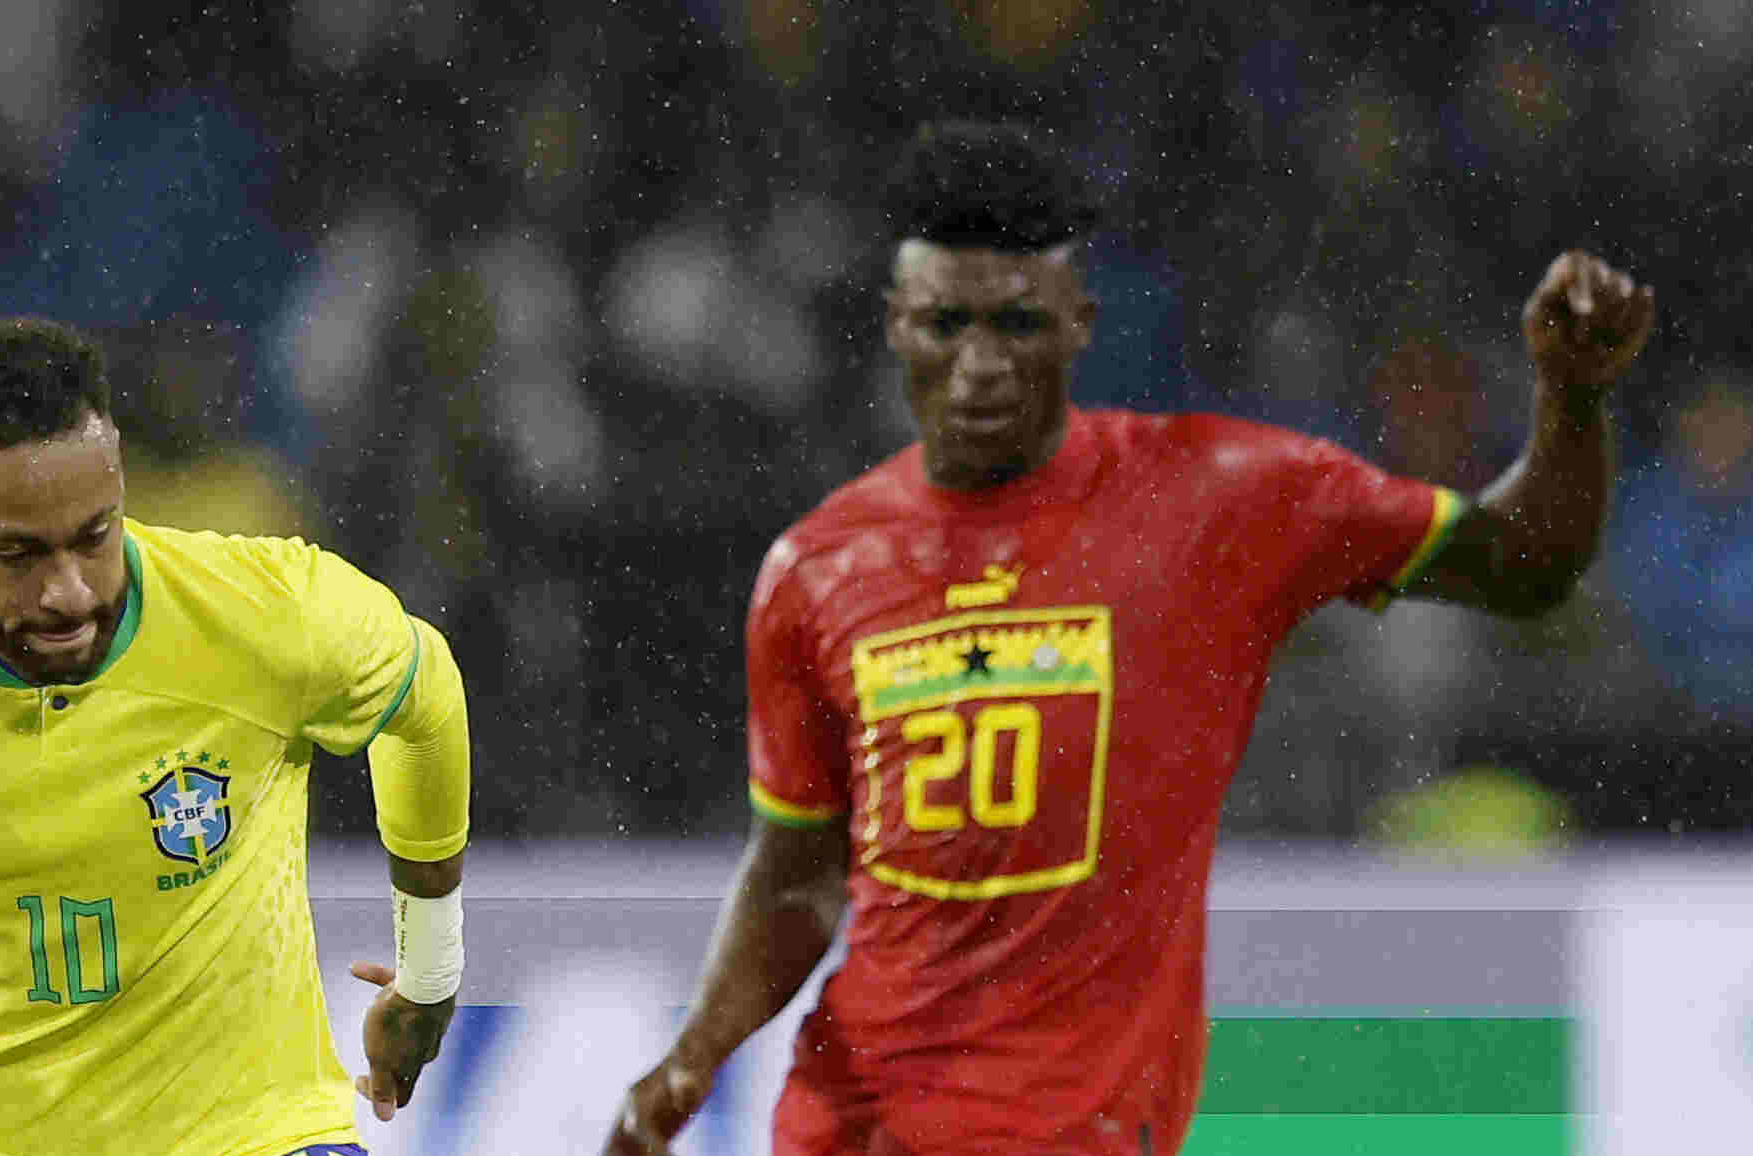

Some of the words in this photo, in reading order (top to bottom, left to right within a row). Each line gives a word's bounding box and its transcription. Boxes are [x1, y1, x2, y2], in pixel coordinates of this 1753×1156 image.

[173, 805, 209, 822] CBF
[902, 703, 1042, 832] 20
[16, 894, 120, 1005] 10
